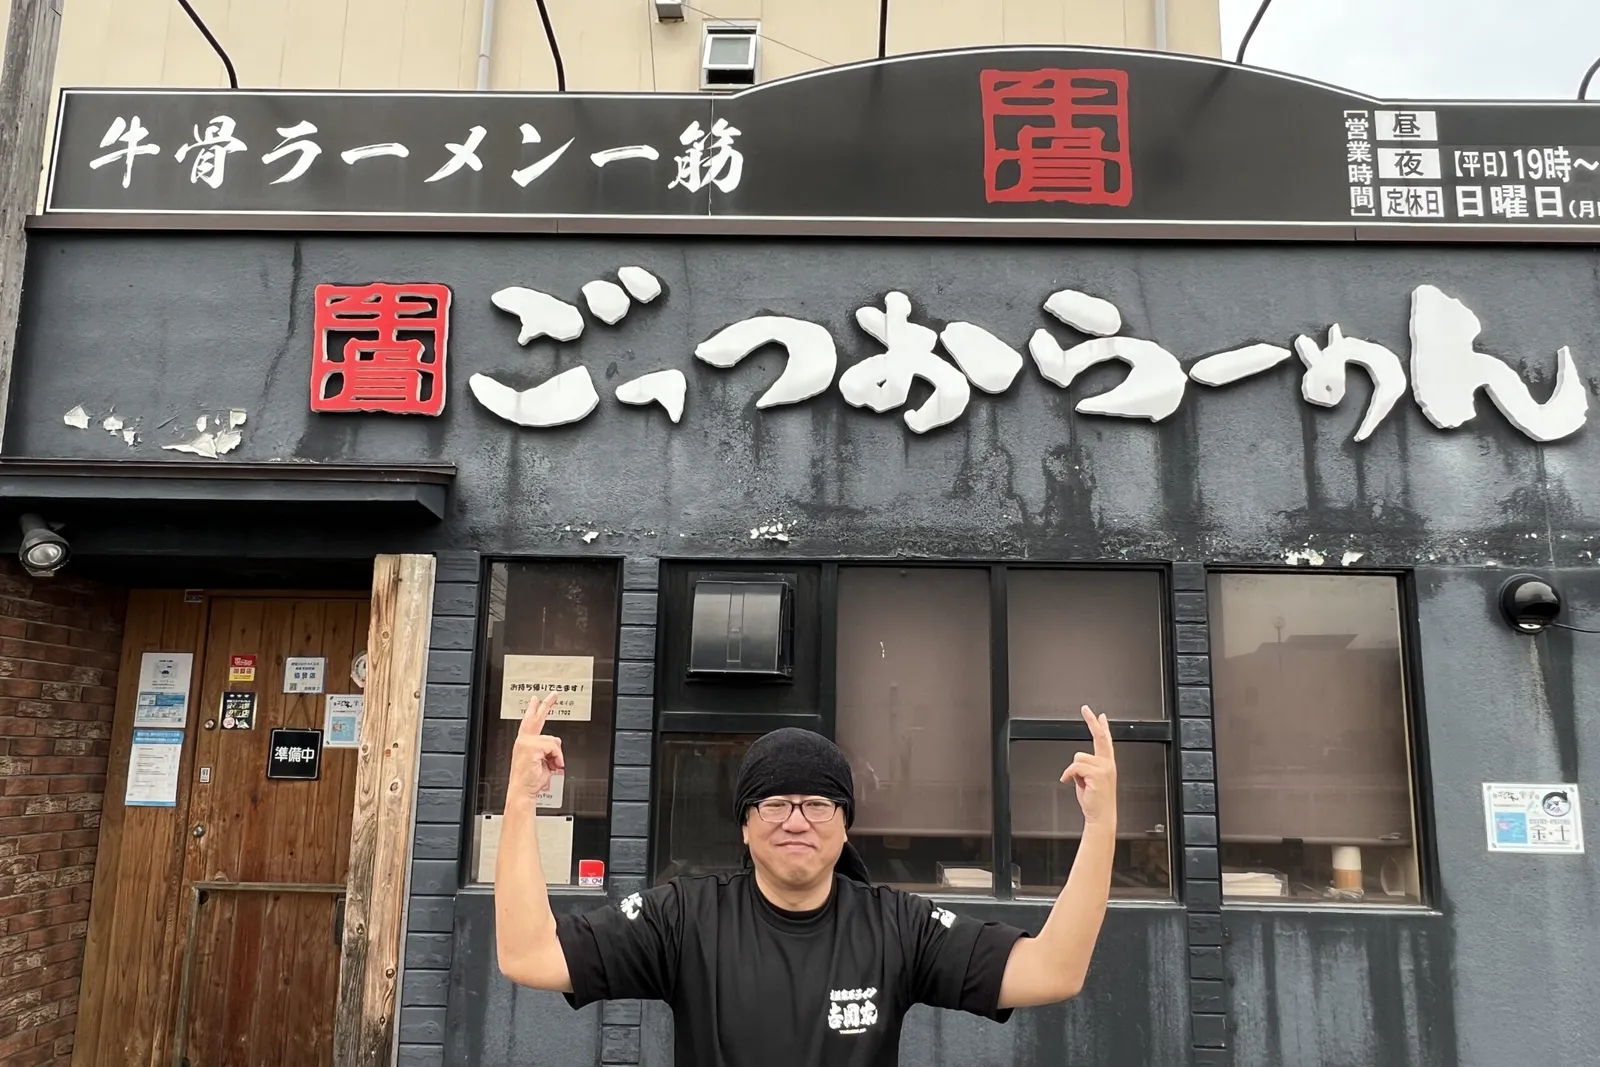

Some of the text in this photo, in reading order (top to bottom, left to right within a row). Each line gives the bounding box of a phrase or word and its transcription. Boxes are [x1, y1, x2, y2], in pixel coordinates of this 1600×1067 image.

[1392, 113, 1422, 138] 昼
[89, 115, 744, 193] 牛骨ラーメン一筋
[1394, 150, 1424, 177] 夜
[1386, 188, 1439, 215] 定休日
[469, 266, 1589, 442] ごっつおらーめん
[510, 683, 585, 692] お持ち帰りできます！
[274, 746, 315, 763] 準備中
